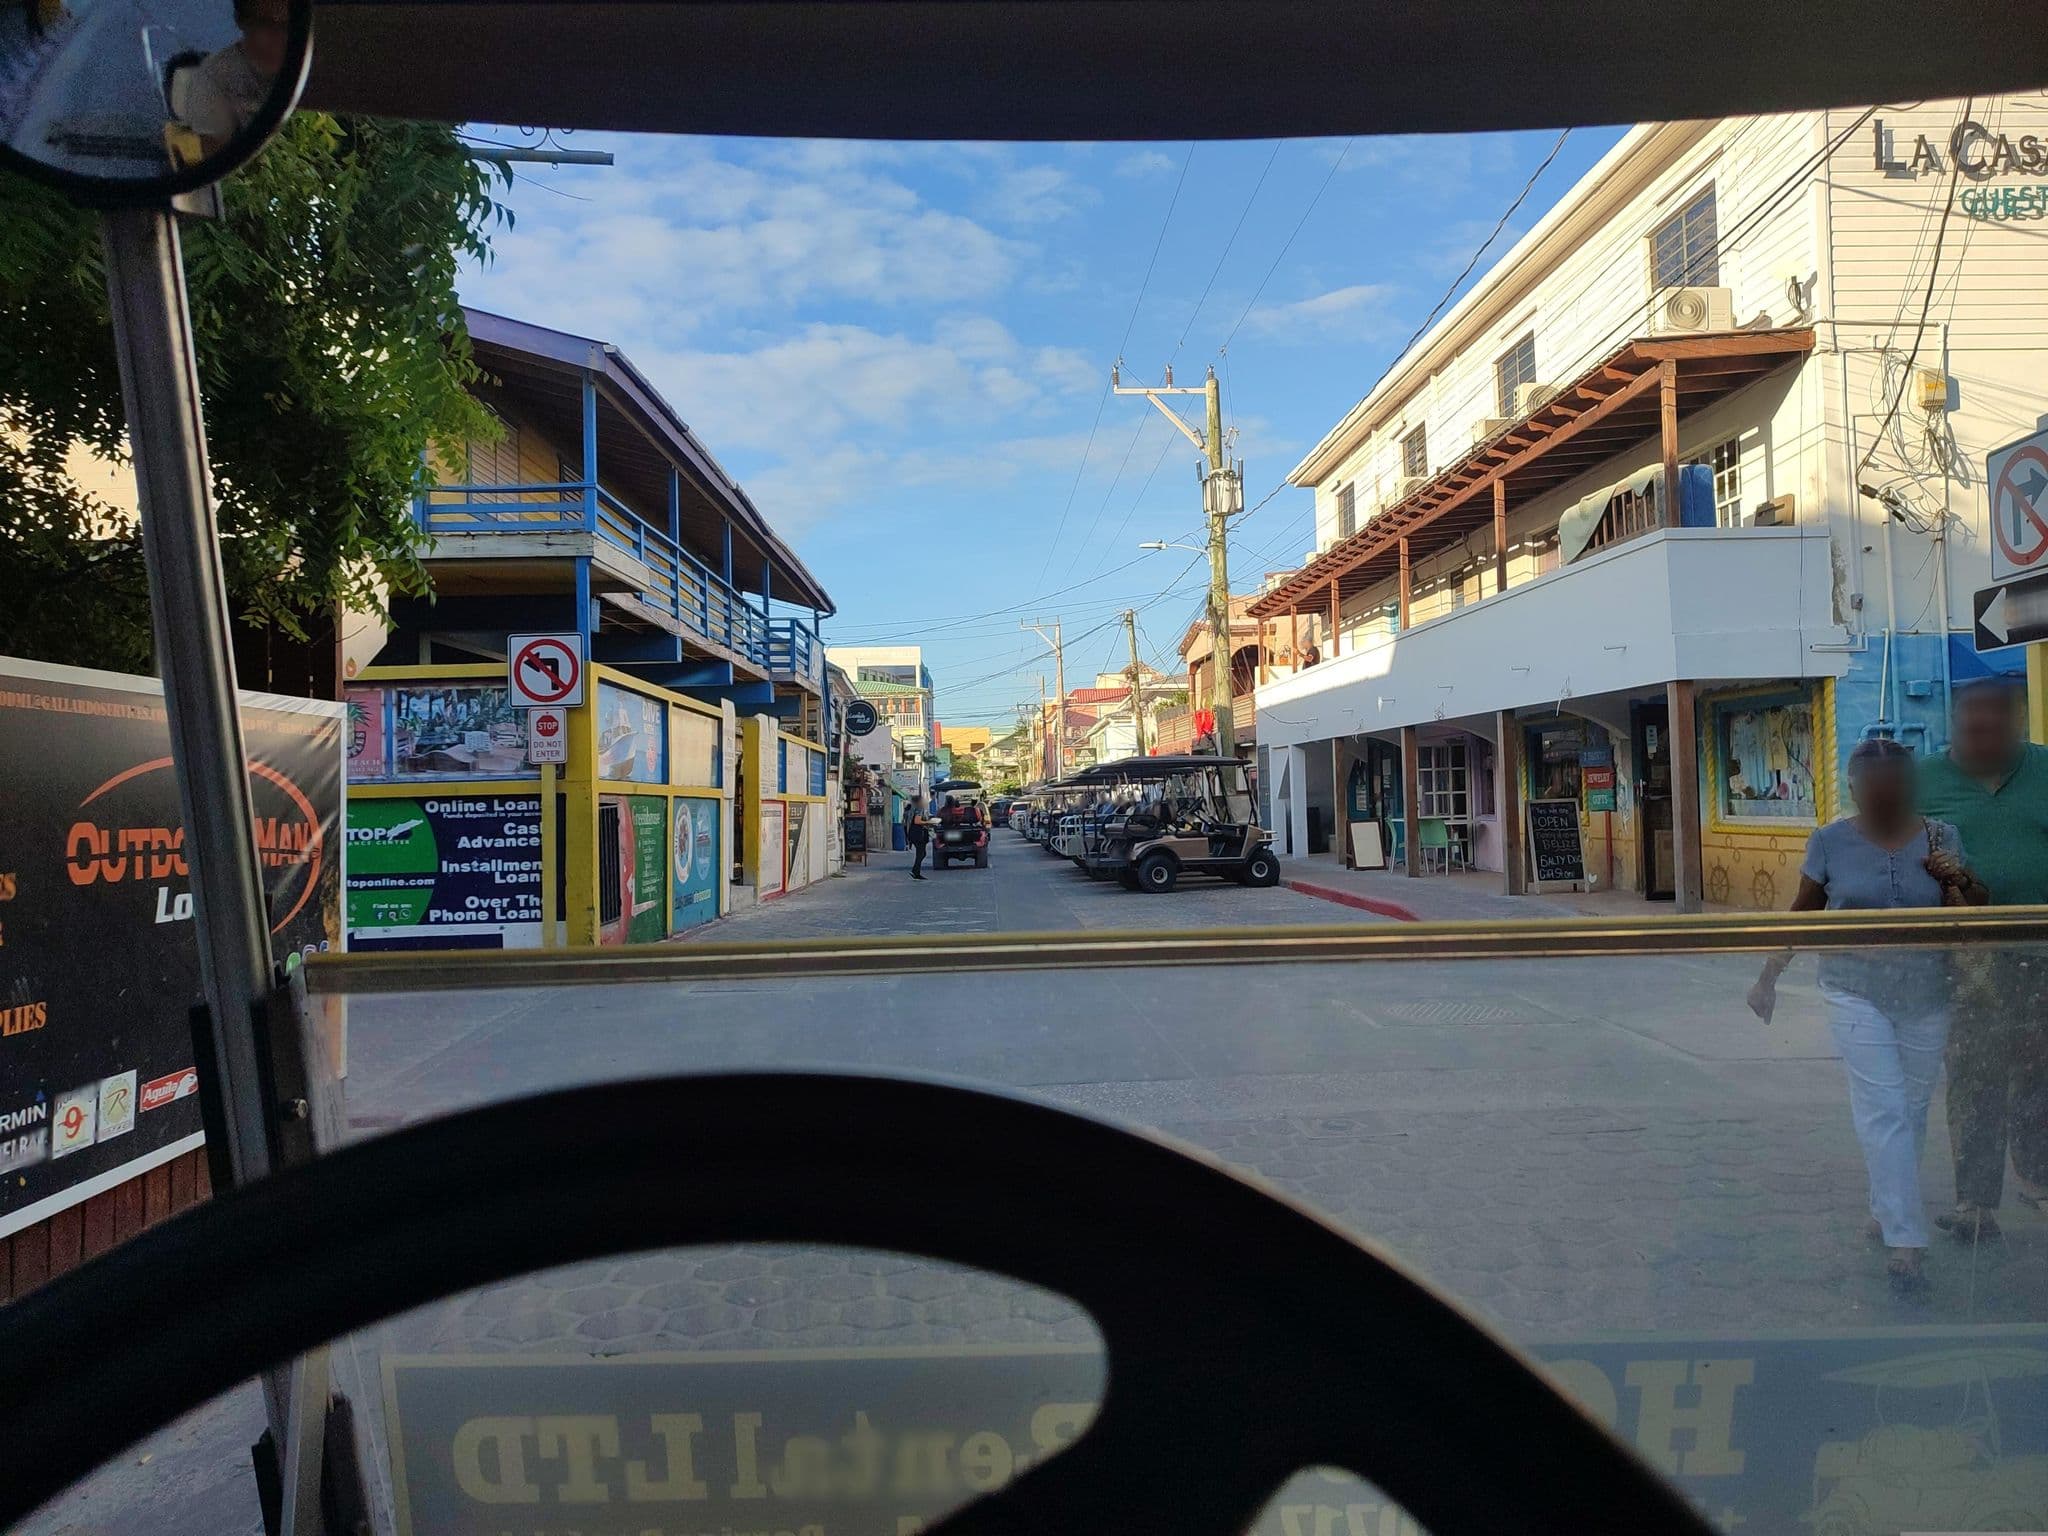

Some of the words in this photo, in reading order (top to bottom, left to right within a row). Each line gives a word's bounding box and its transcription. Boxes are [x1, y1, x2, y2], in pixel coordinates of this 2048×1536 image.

[1873, 119, 1942, 173] LA
[1950, 121, 2048, 174] CAS
[537, 721, 559, 730] STOP
[546, 740, 561, 748] NOT
[424, 800, 487, 814] Online
[493, 799, 542, 812] Loan
[503, 822, 542, 836] Cas
[1538, 816, 1569, 828] OPEN
[457, 836, 541, 849] Advance
[66, 821, 190, 886] OUTDO
[442, 860, 542, 873] Installmen
[347, 878, 435, 889] toponline.com
[495, 870, 541, 884] Loan
[155, 887, 194, 924] Lo
[465, 896, 510, 909] Over
[516, 894, 542, 907] Th
[429, 909, 489, 922] Phone
[496, 907, 541, 920] Loan
[143, 1081, 178, 1104] Aguila
